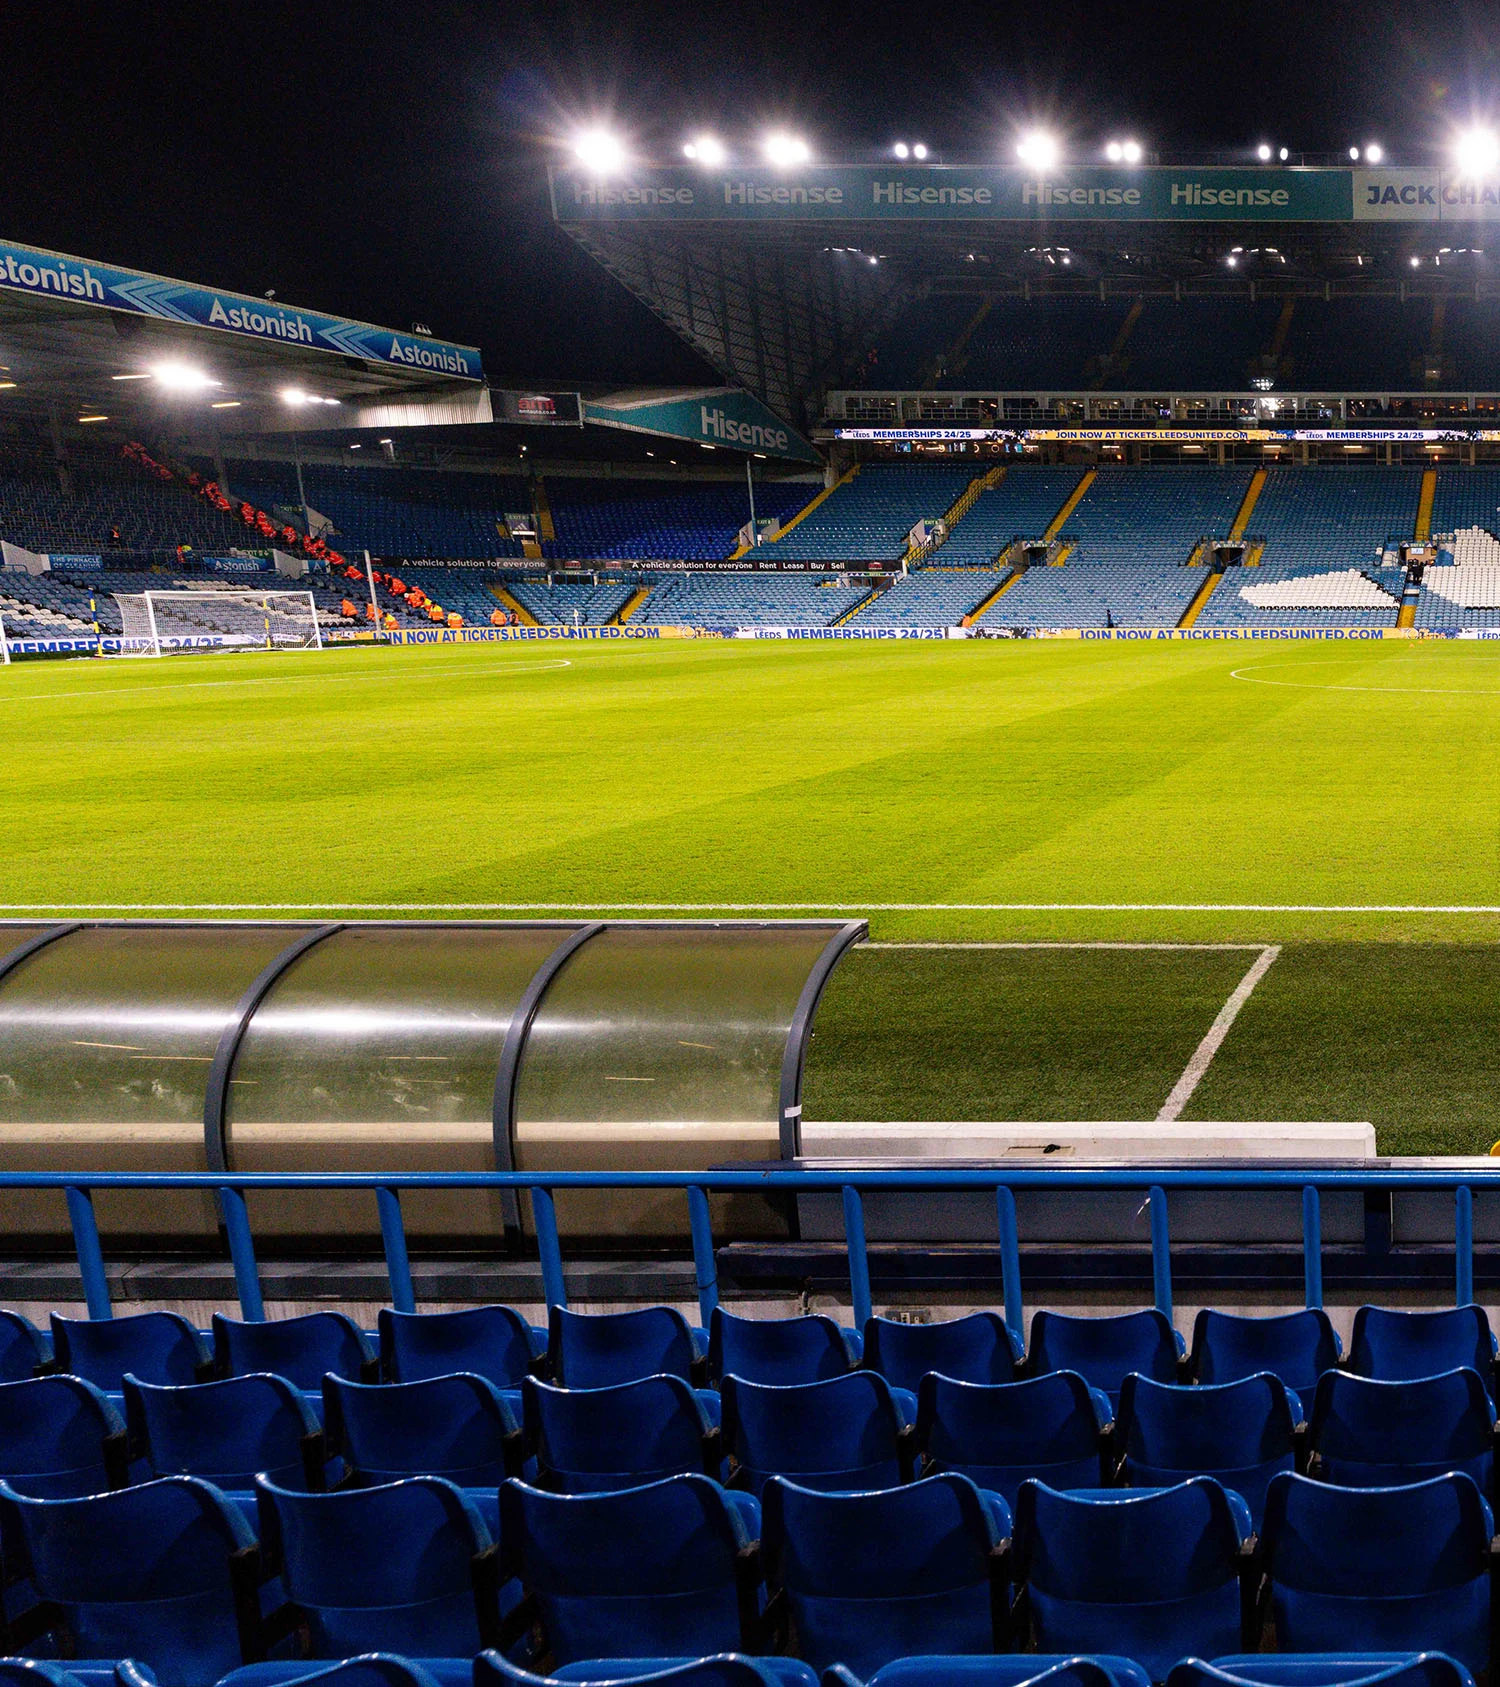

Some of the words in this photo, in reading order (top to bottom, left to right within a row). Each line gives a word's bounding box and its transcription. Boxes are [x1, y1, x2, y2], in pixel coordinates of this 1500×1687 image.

[724, 182, 843, 204] Hisense
[873, 182, 992, 204] Hisense
[1022, 183, 1140, 205] Hisense
[1171, 183, 1289, 205] Hisense
[1367, 185, 1436, 205] JACK
[0, 256, 104, 300] tonish
[209, 297, 312, 342] Astonish
[390, 337, 469, 374] Astonish
[701, 406, 788, 450] Hisense
[873, 430, 942, 438] MEMBERSHIPS
[944, 430, 971, 438] 24/25
[1056, 431, 1077, 439] JOIN
[1079, 431, 1102, 439] NOW
[1105, 431, 1116, 439] AT
[1327, 431, 1395, 439] MEMBERSHIPS
[1397, 431, 1424, 439] 24/25
[214, 559, 260, 573] Astonish
[412, 559, 444, 567] vehicle
[447, 559, 485, 567] solution
[487, 559, 500, 567] for
[503, 561, 546, 569] everyone
[718, 562, 753, 571] everyone
[810, 562, 825, 571] Buy
[407, 632, 440, 643] NOW
[442, 631, 456, 642] AT
[461, 627, 659, 641] TICKETS.LEEDSUNITED.COM
[787, 629, 896, 639] MEMBERSHIPS
[901, 629, 943, 639] 24/25
[1080, 630, 1111, 639] JOIN
[1116, 630, 1154, 639] NOW
[1157, 630, 1175, 639] AT
[7, 639, 162, 653] MEMBERSHIP
